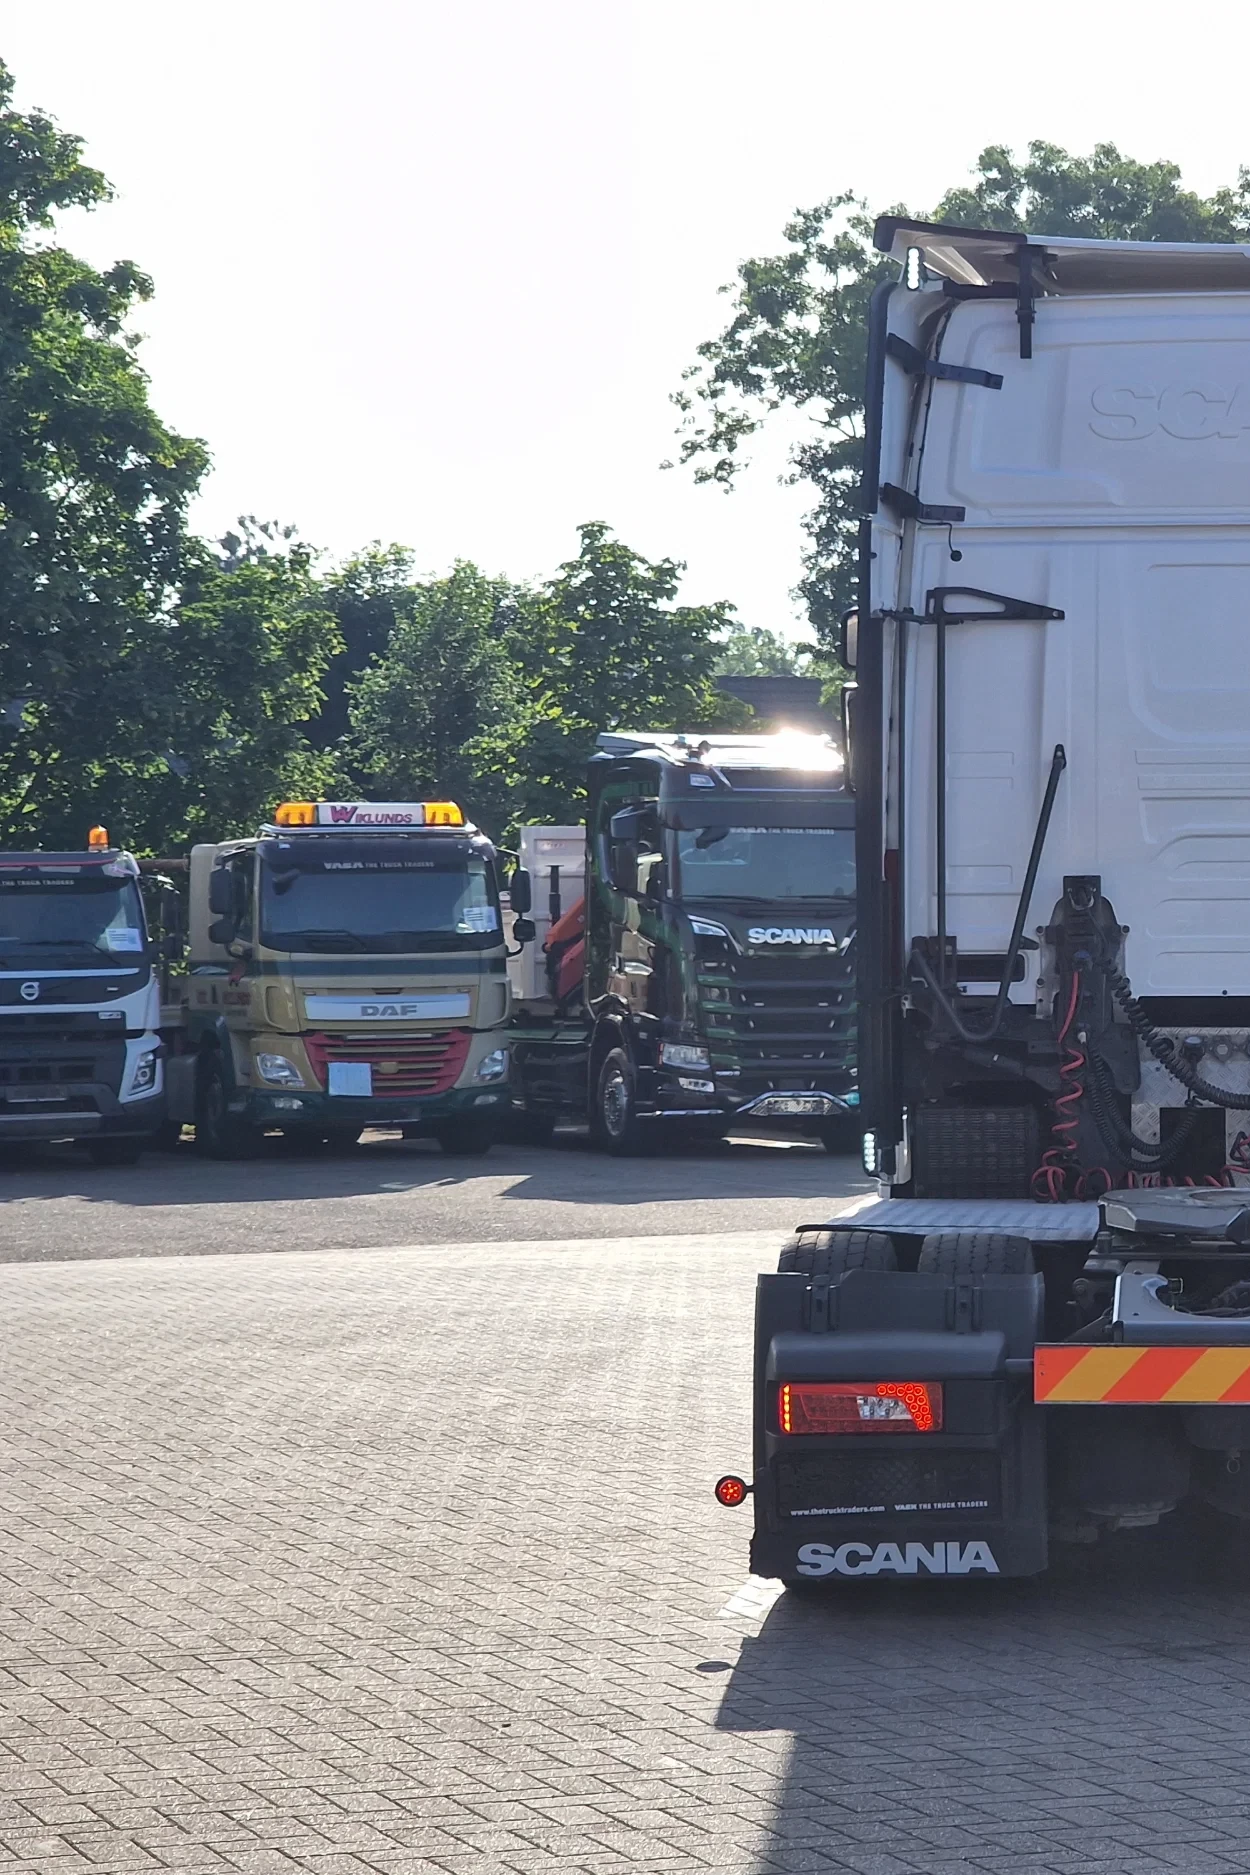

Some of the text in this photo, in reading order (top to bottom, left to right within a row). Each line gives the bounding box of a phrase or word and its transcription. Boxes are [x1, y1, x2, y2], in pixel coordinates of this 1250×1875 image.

[748, 927, 836, 945] SCANIA
[360, 1005, 418, 1017] DAF
[790, 1505, 885, 1517] www.thetrucktraders.com
[933, 1501, 956, 1509] TRUCK
[957, 1500, 988, 1508] TRADERS
[796, 1541, 1000, 1576] SCANIA
